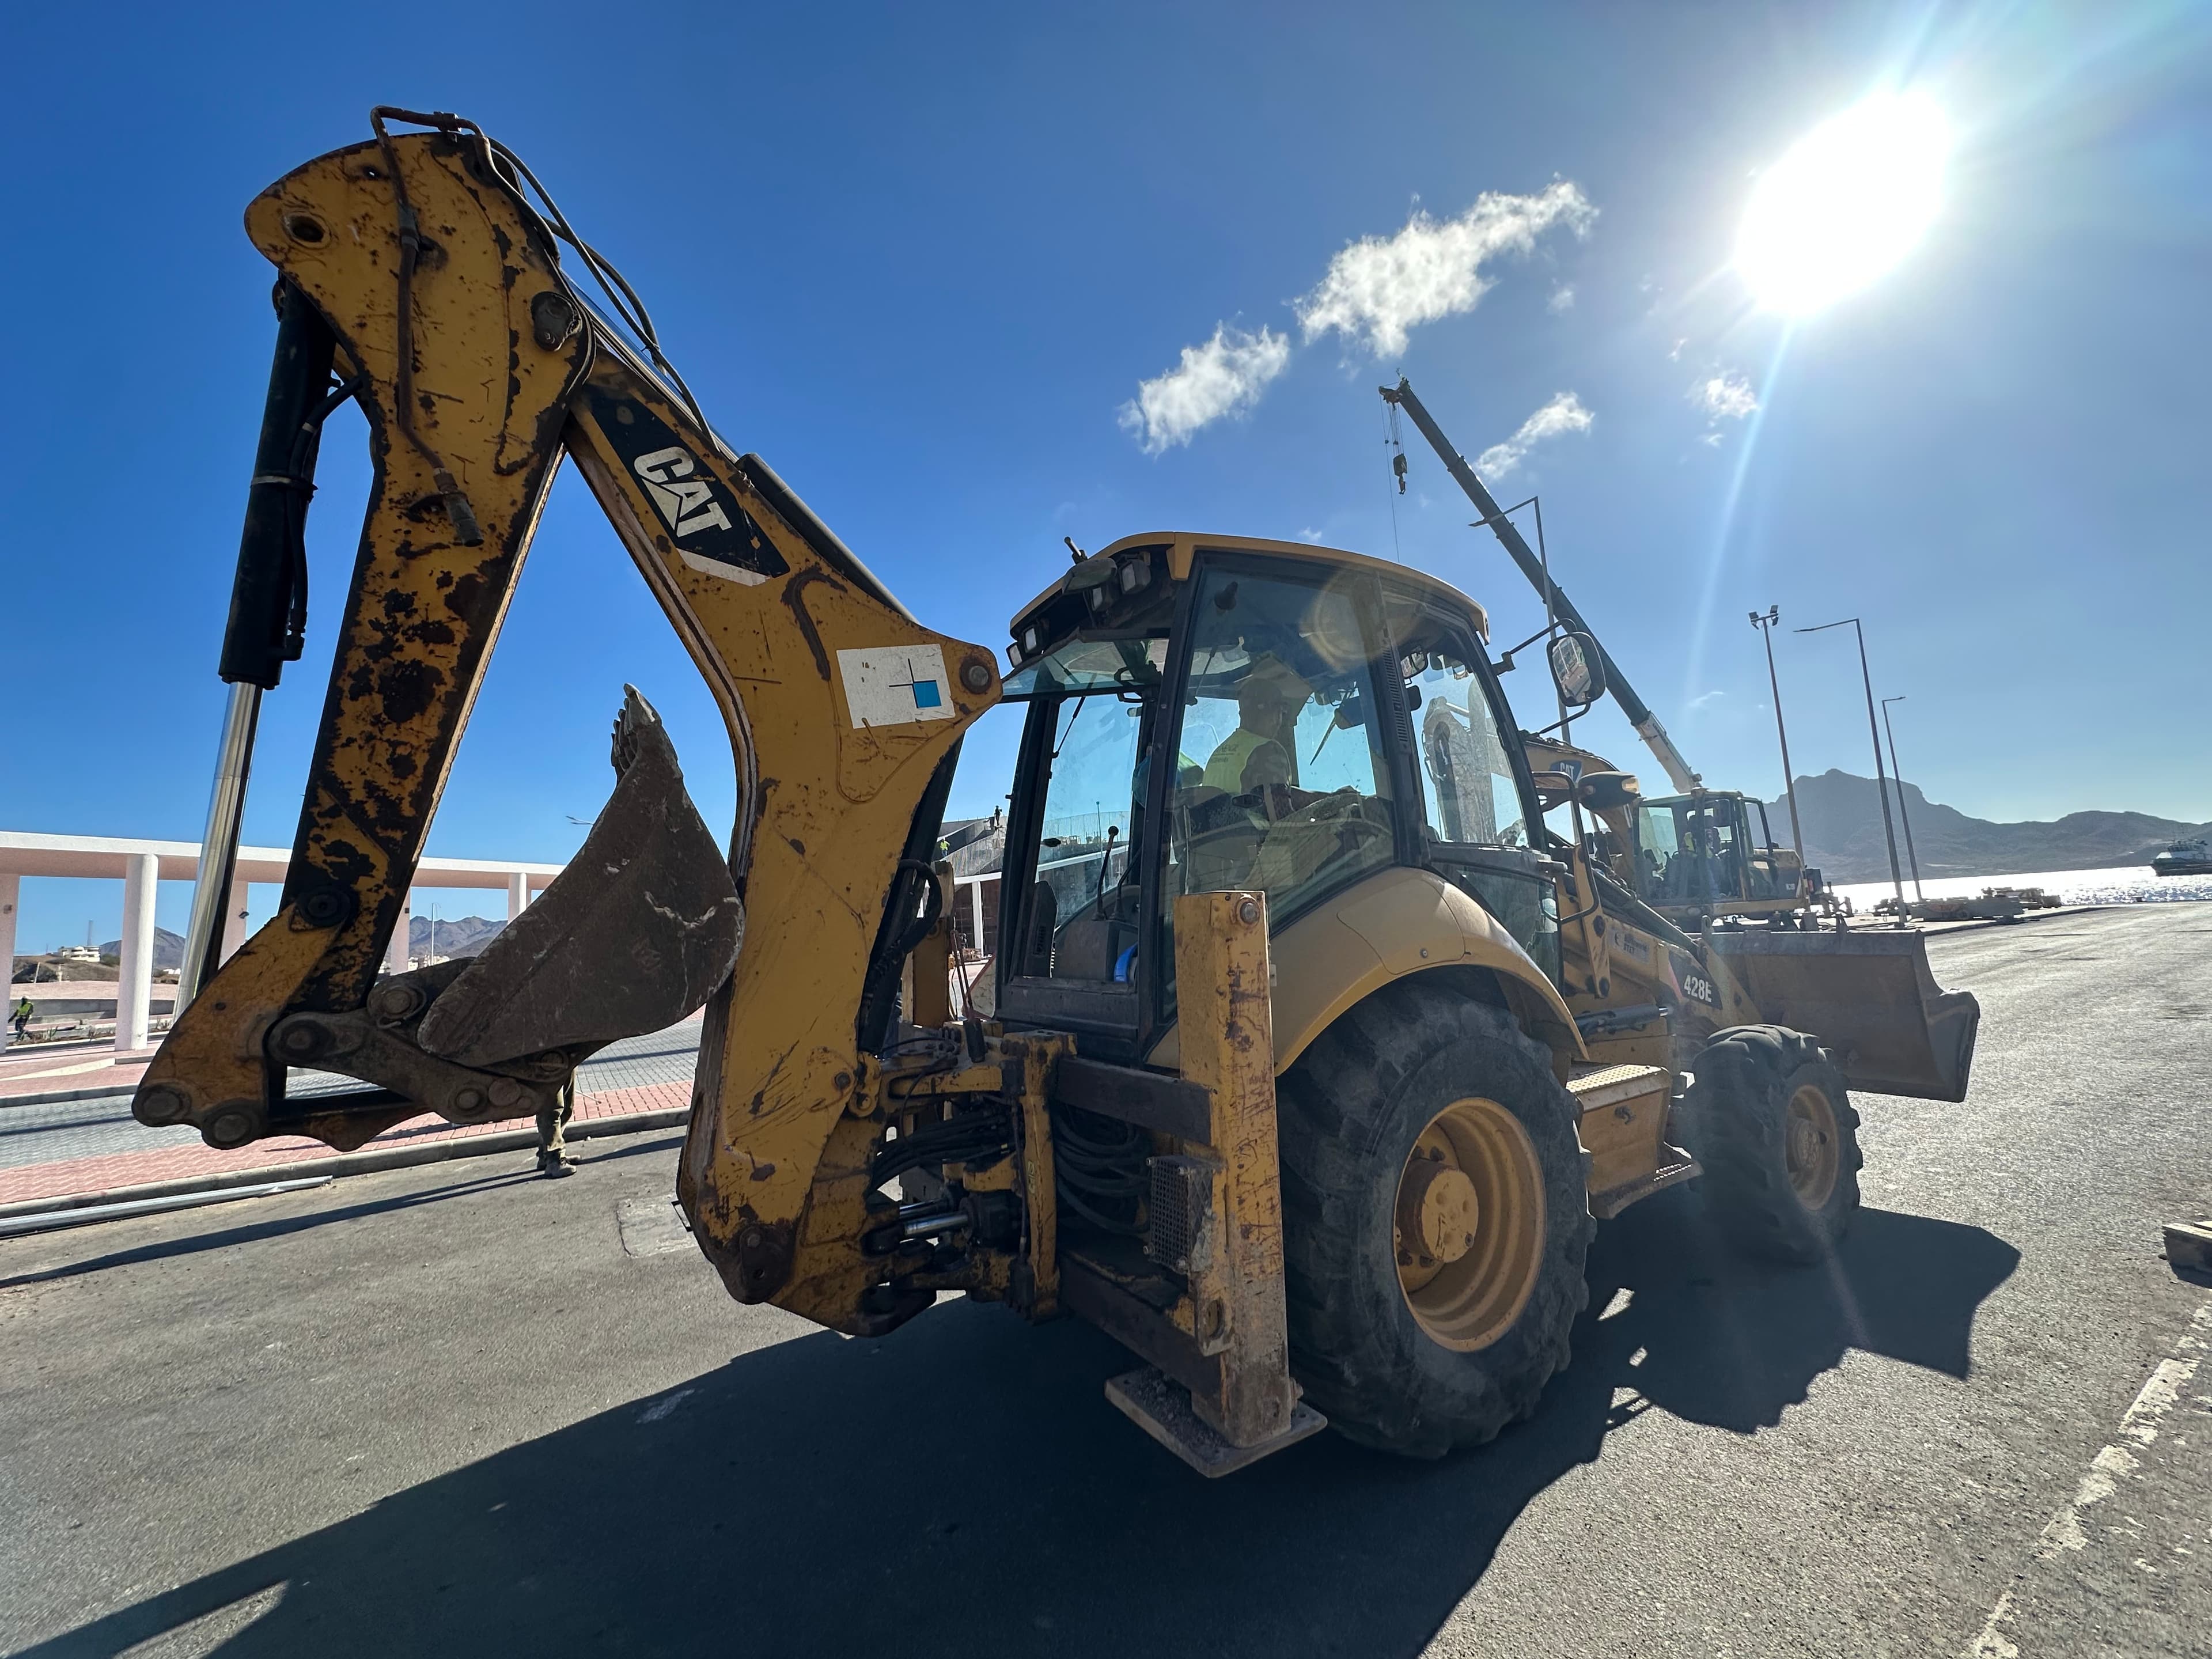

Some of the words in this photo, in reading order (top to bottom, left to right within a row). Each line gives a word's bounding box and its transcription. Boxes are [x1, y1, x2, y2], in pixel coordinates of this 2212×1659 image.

[634, 446, 732, 537] CAT
[1560, 762, 1574, 779] CAT
[1684, 975, 1712, 1002] 428E
